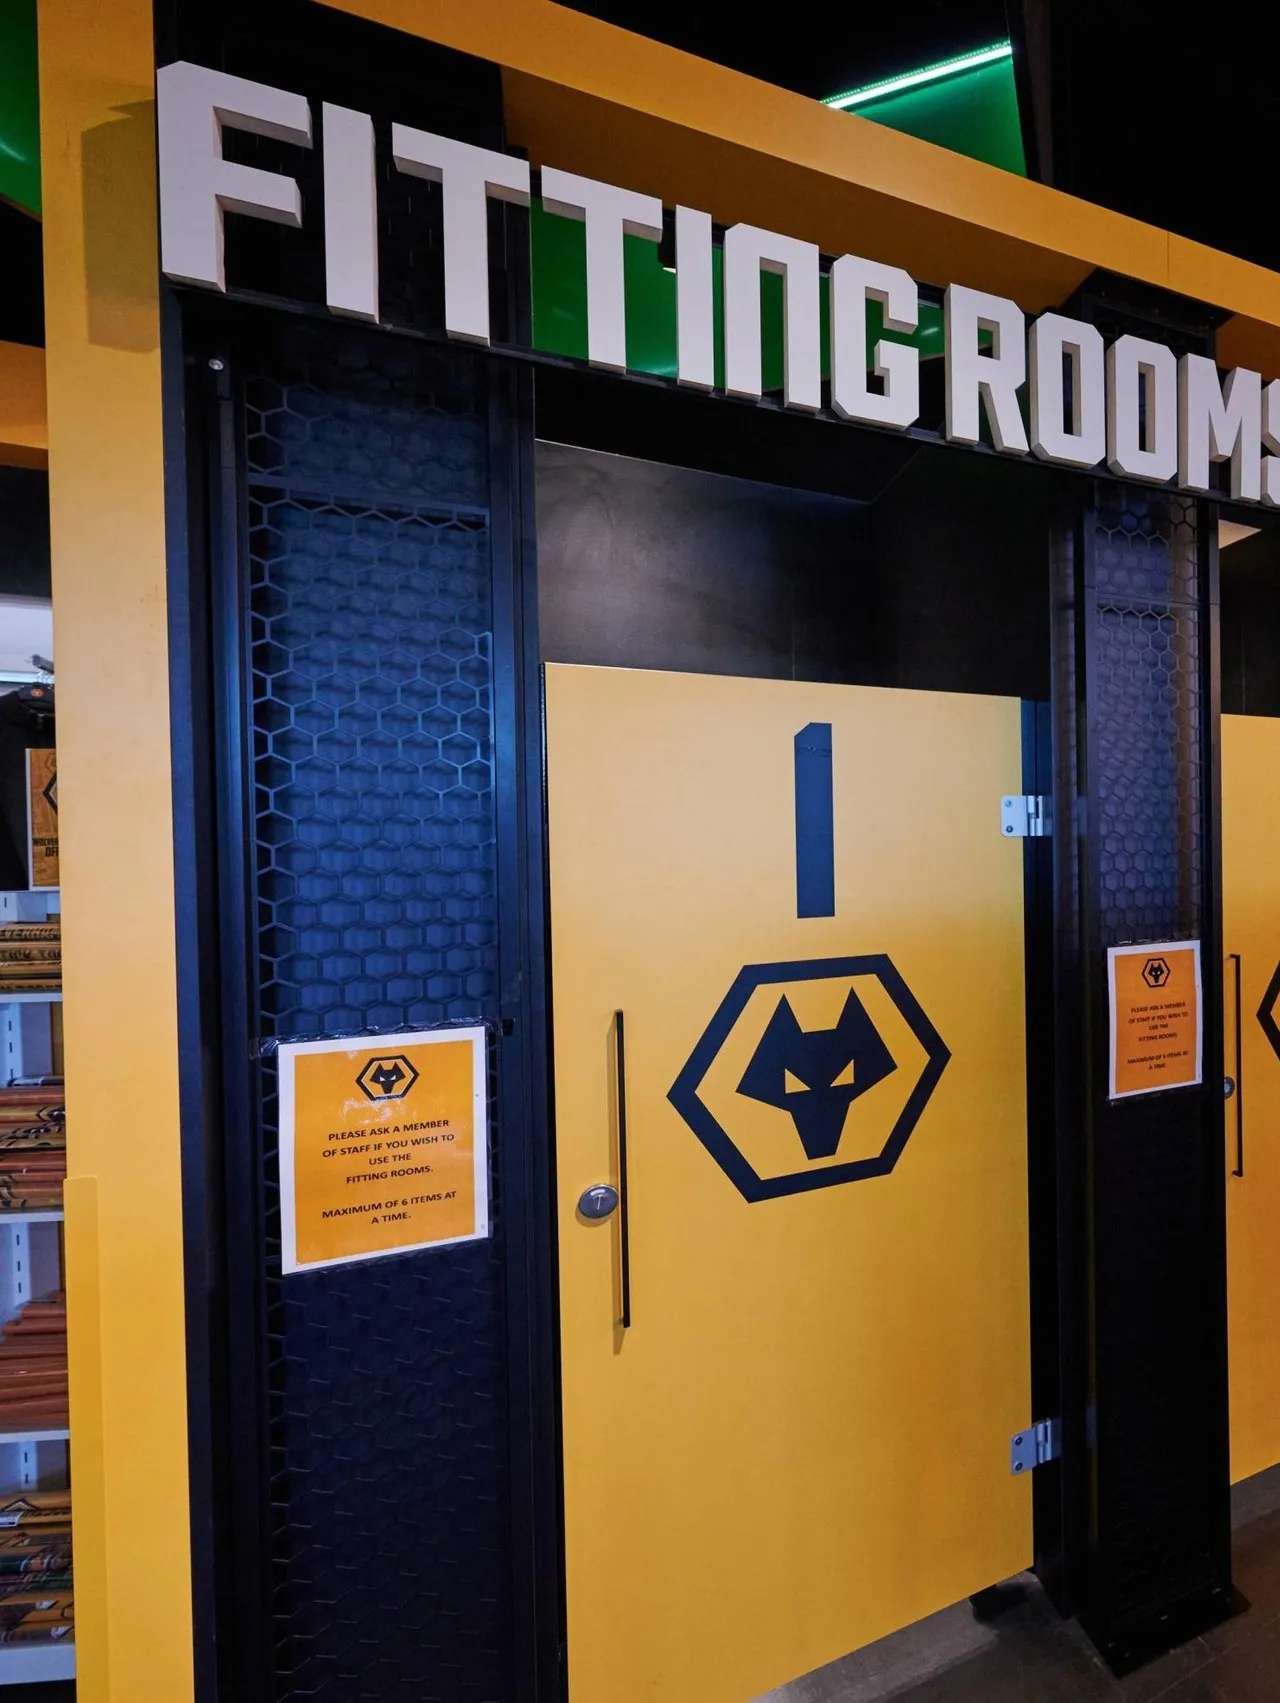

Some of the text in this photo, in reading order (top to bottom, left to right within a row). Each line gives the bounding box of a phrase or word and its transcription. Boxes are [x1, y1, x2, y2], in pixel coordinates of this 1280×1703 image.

[156, 60, 919, 430] FITTING
[794, 722, 835, 919] 1
[328, 1119, 449, 1141] PLEASE ASK A MEMBER
[322, 1133, 455, 1158] OF STAFF IF YOU WISH TO
[368, 1152, 412, 1166] USE THE
[346, 1165, 434, 1184] FITTING ROOMS.
[322, 1190, 457, 1219] MAXIMUM OF 6 ITEMS AT
[370, 1211, 411, 1225] A TIME.
